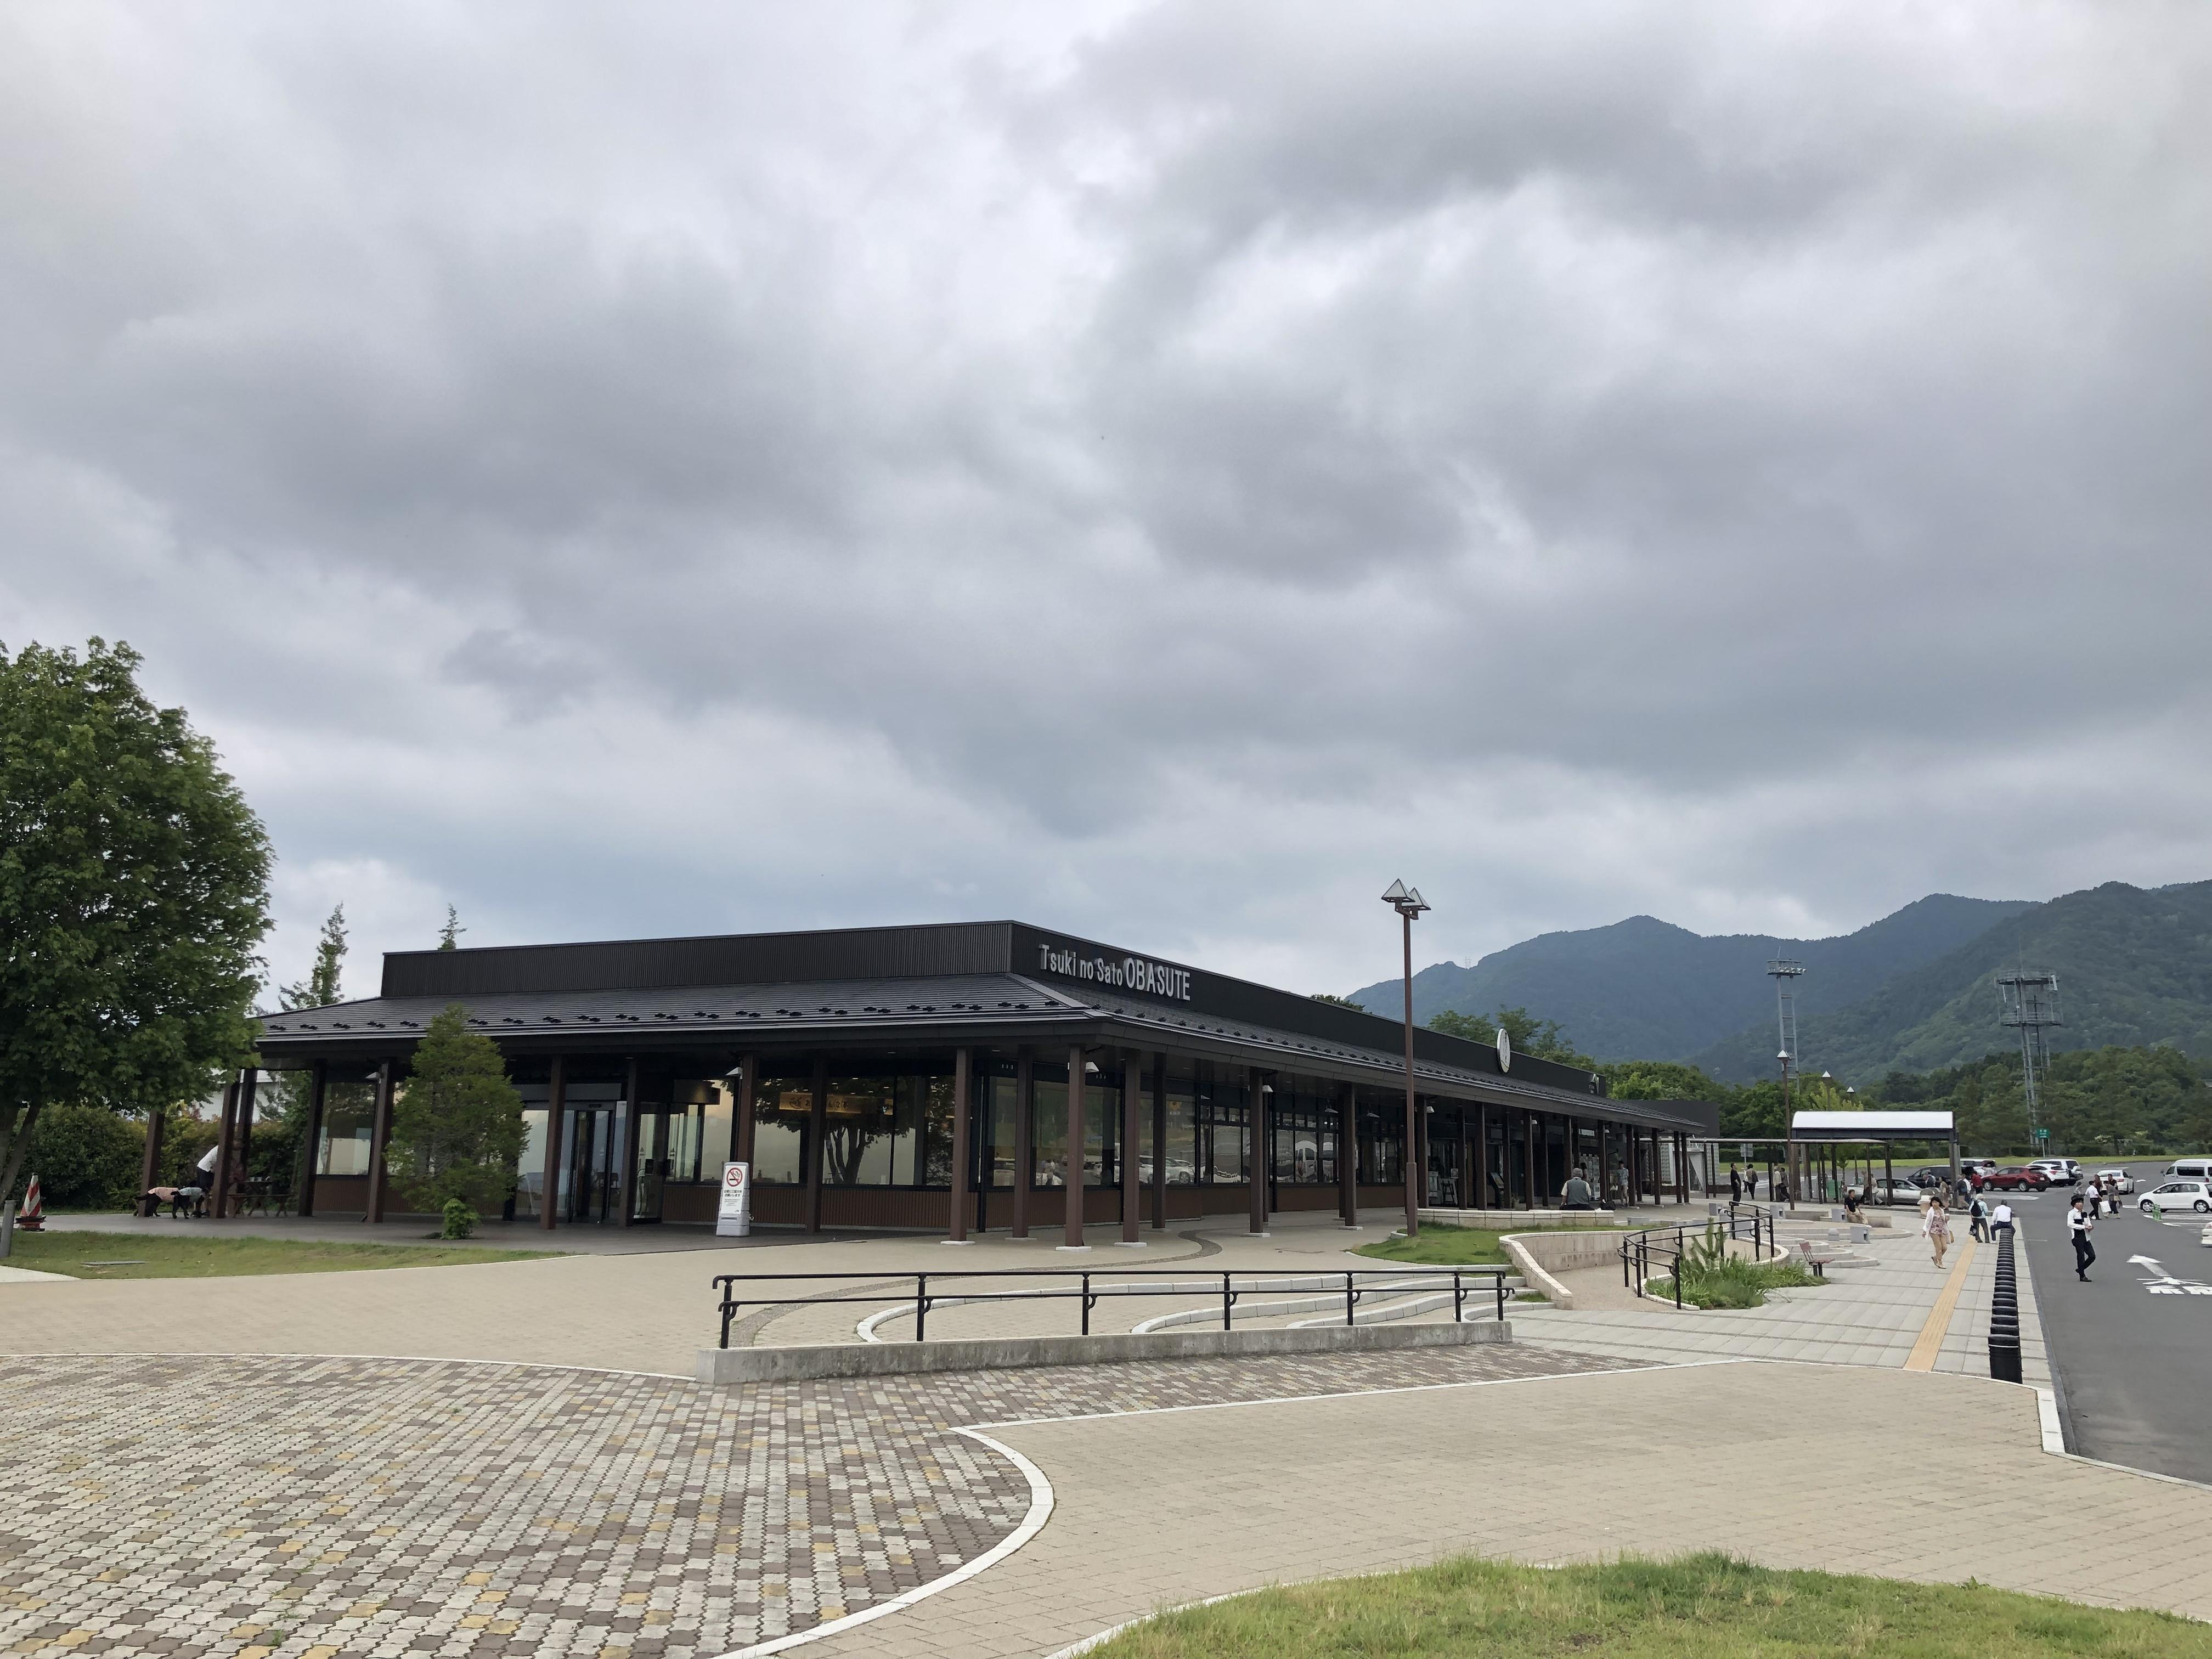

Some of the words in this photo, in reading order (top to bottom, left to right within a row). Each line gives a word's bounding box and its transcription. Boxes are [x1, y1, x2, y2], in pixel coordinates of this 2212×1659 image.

[1039, 944, 1076, 977] Tsuki
[1080, 958, 1094, 980] no
[1096, 957, 1123, 986] Sato
[1124, 957, 1190, 1001] OBASUTE
